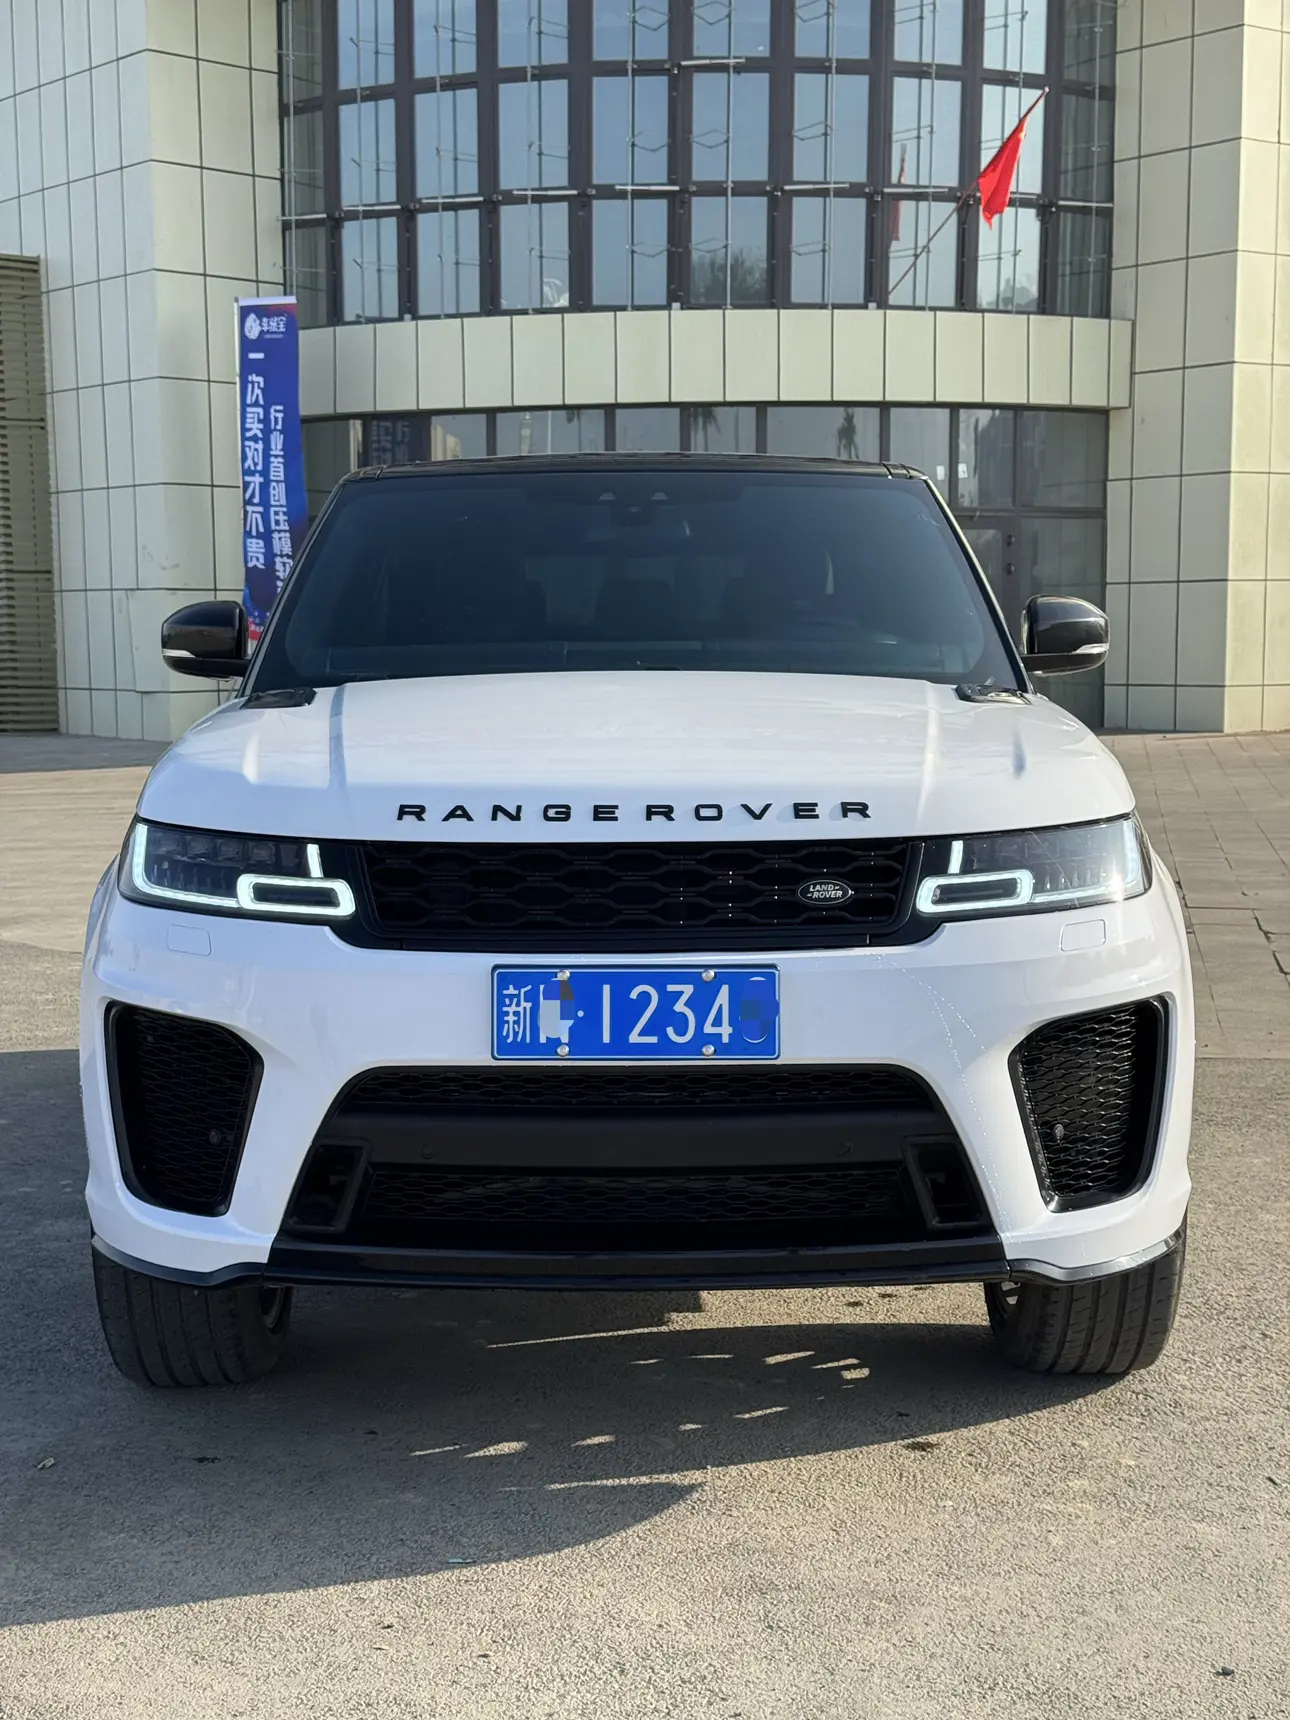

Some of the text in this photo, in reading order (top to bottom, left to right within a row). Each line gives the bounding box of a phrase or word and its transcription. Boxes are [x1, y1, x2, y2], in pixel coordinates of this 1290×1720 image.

[244, 352, 266, 569] 一次买对才不贵
[269, 405, 294, 594] 行业首创压模软
[397, 801, 871, 822] RANGE ROVER
